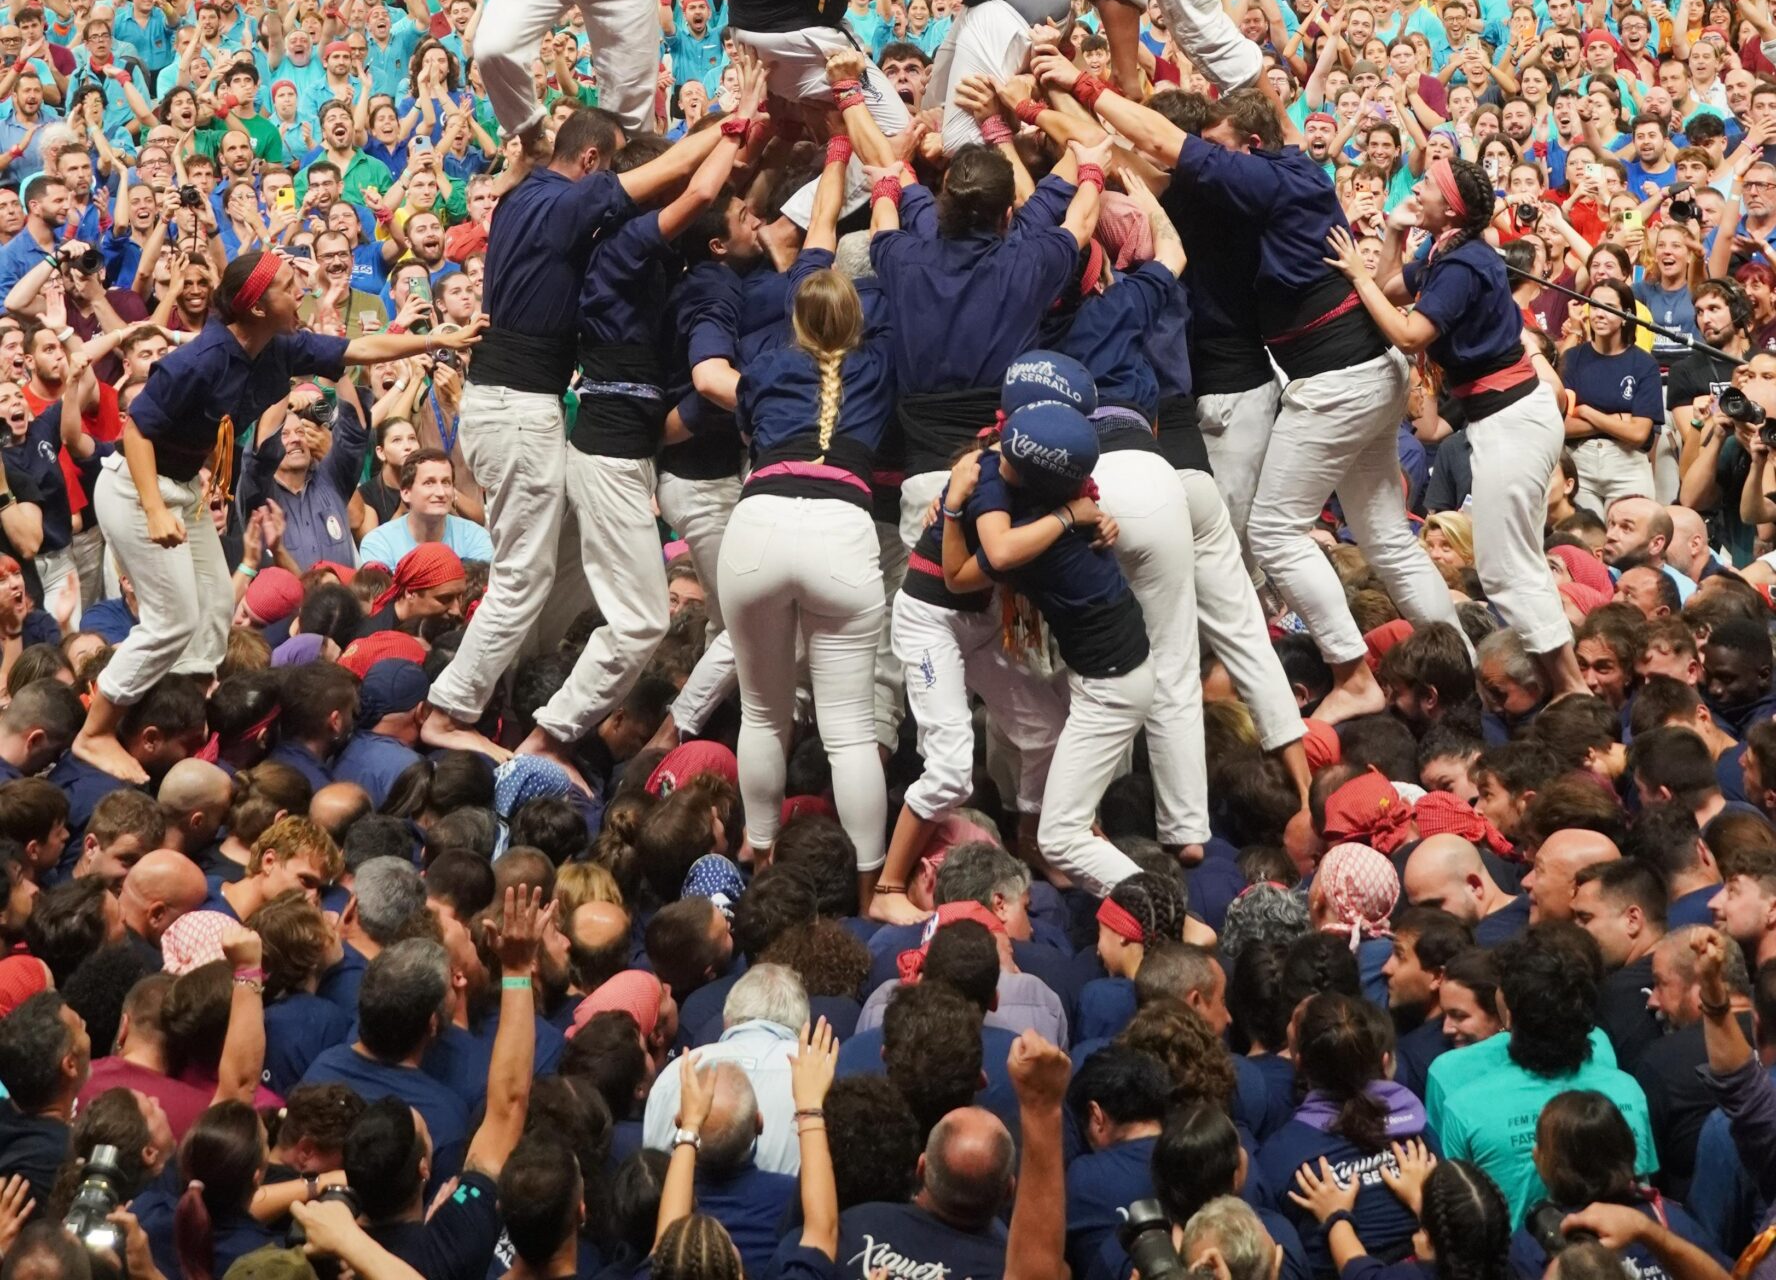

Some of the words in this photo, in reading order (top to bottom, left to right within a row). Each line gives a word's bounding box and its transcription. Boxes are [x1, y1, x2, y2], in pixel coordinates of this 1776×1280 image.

[1020, 372, 1082, 403] SERRALLO
[1055, 373, 1070, 386] DEL
[1004, 428, 1073, 465] Xiquets
